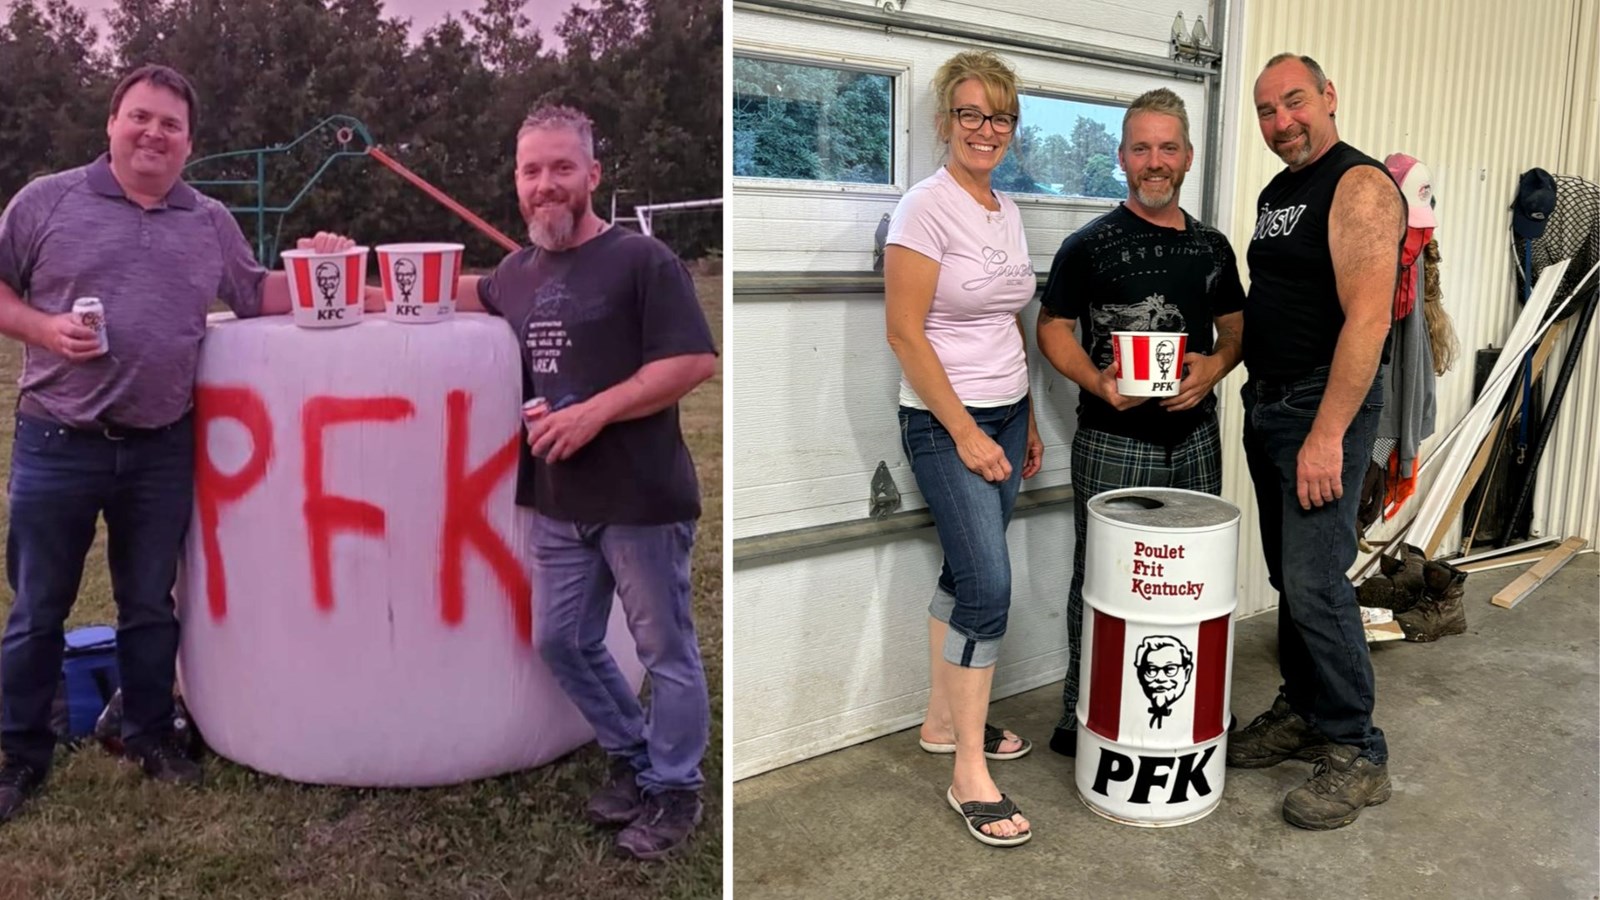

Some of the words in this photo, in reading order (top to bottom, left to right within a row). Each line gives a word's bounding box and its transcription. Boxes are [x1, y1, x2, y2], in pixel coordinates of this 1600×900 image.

[317, 309, 346, 320] KFC
[396, 305, 423, 316] KFC
[1152, 382, 1174, 392] PFK
[193, 384, 533, 646] PFK
[1134, 541, 1185, 559] Poulet
[1133, 559, 1164, 577] Frit
[1131, 578, 1204, 600] Kentucky
[1091, 745, 1218, 804] PFK
